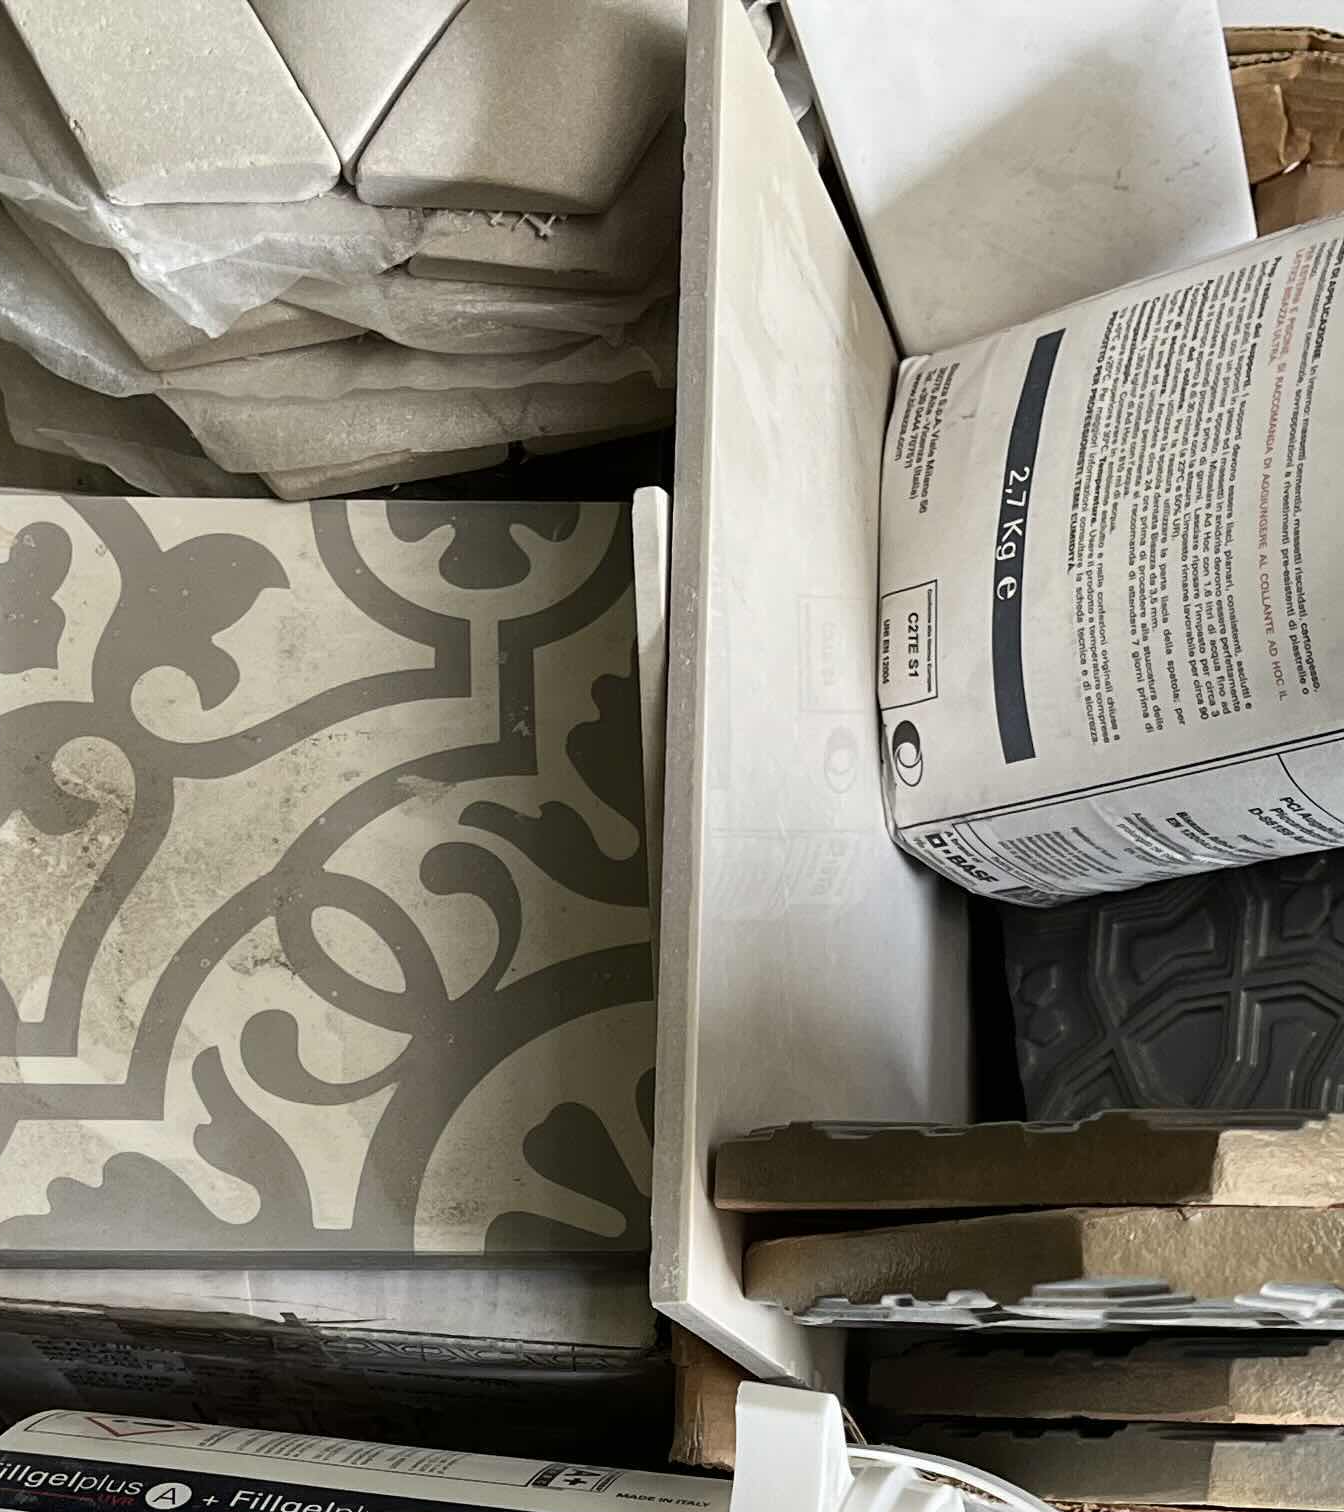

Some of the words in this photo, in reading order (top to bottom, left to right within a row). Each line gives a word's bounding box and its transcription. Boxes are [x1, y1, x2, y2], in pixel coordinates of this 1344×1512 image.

[1002, 464, 1030, 507] 2,7
[994, 516, 1024, 562] Kg
[1259, 554, 1267, 568] AL
[1259, 573, 1274, 635] COLLANTE
[908, 612, 919, 654] C2TE
[1266, 639, 1278, 656] AD
[1297, 621, 1322, 693] cartongesso,
[908, 659, 919, 677] S1
[1272, 661, 1284, 686] HOC
[1278, 690, 1287, 700] IL
[947, 855, 999, 884] BASF
[616, 1491, 655, 1503] MADE
[658, 1496, 673, 1505] IN
[674, 1498, 711, 1508] ITALY
